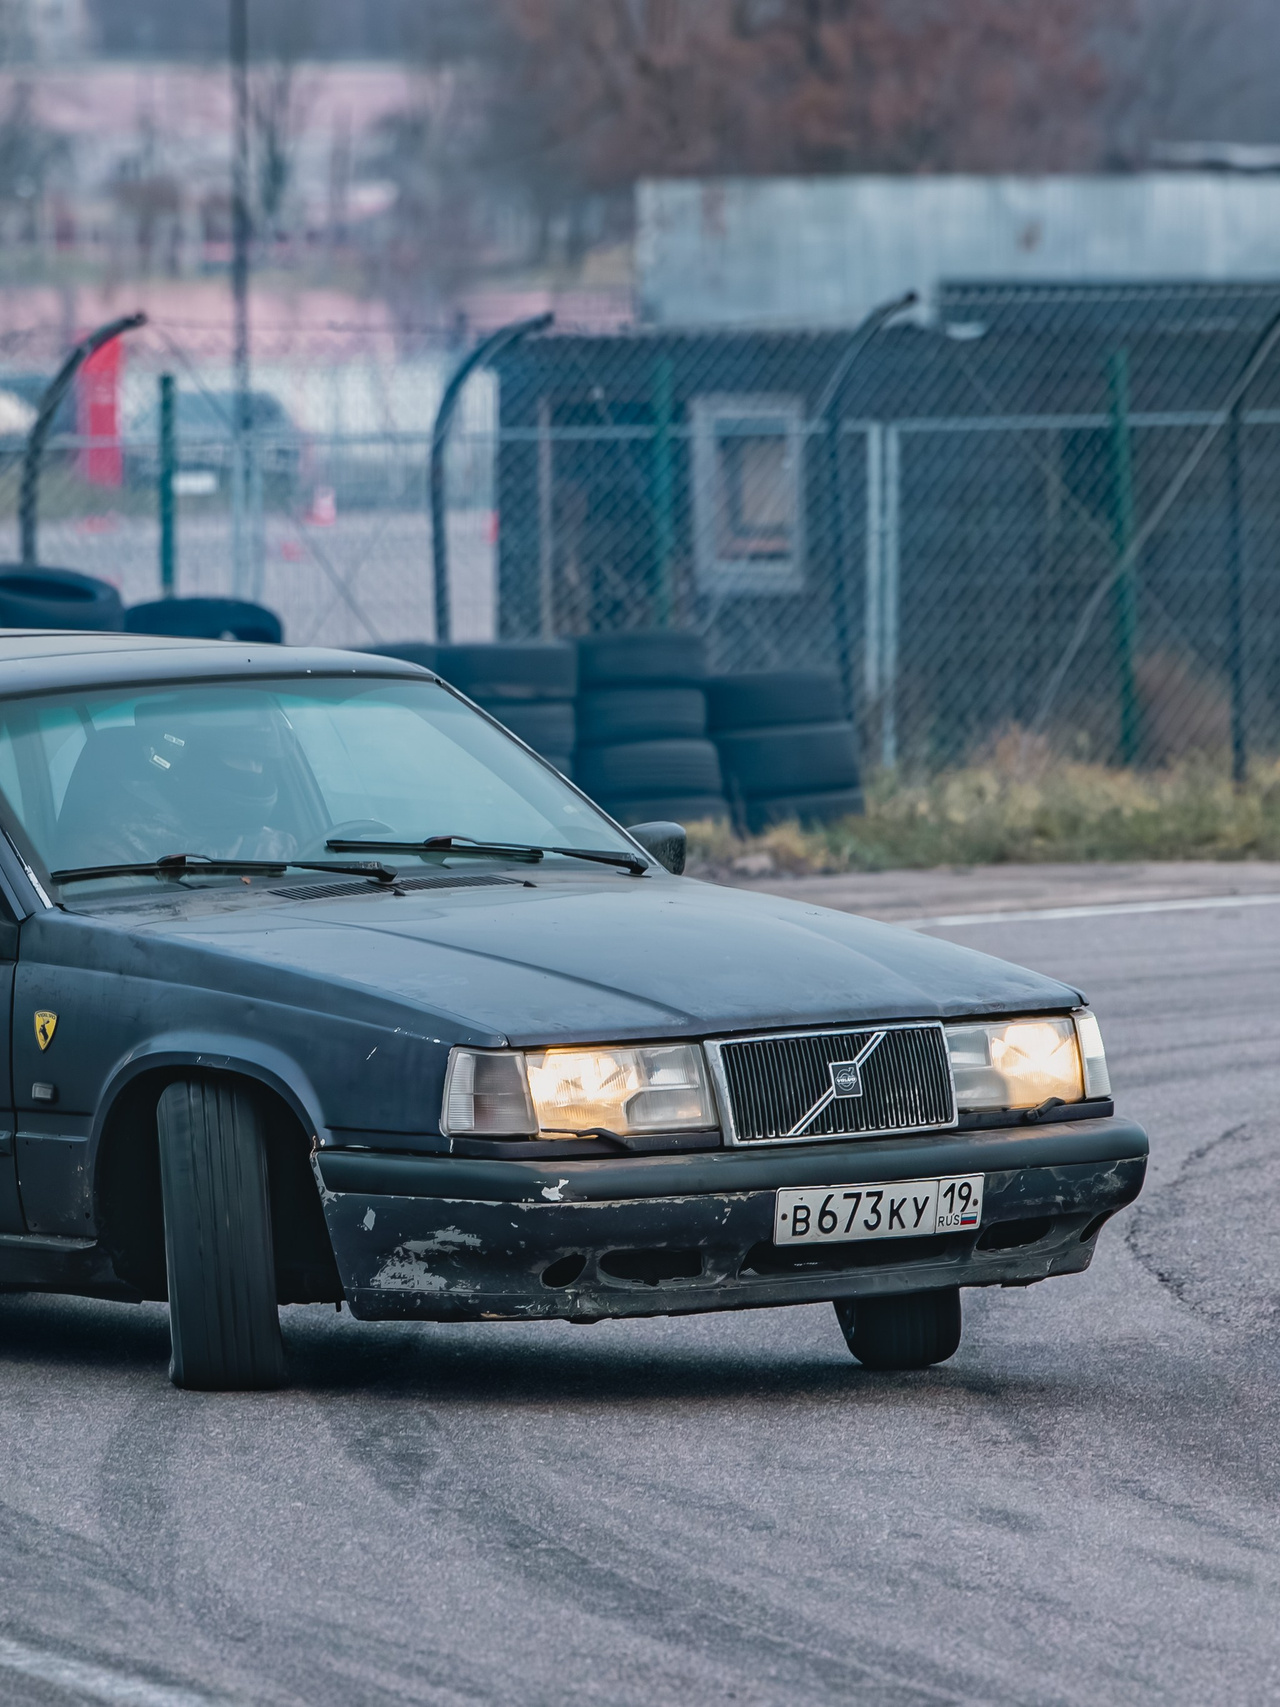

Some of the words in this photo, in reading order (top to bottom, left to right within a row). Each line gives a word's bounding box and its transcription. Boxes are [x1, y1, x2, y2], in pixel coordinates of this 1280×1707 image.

[791, 1190, 930, 1237] В673КУ
[942, 1181, 972, 1214] 19
[937, 1214, 960, 1228] RUS
